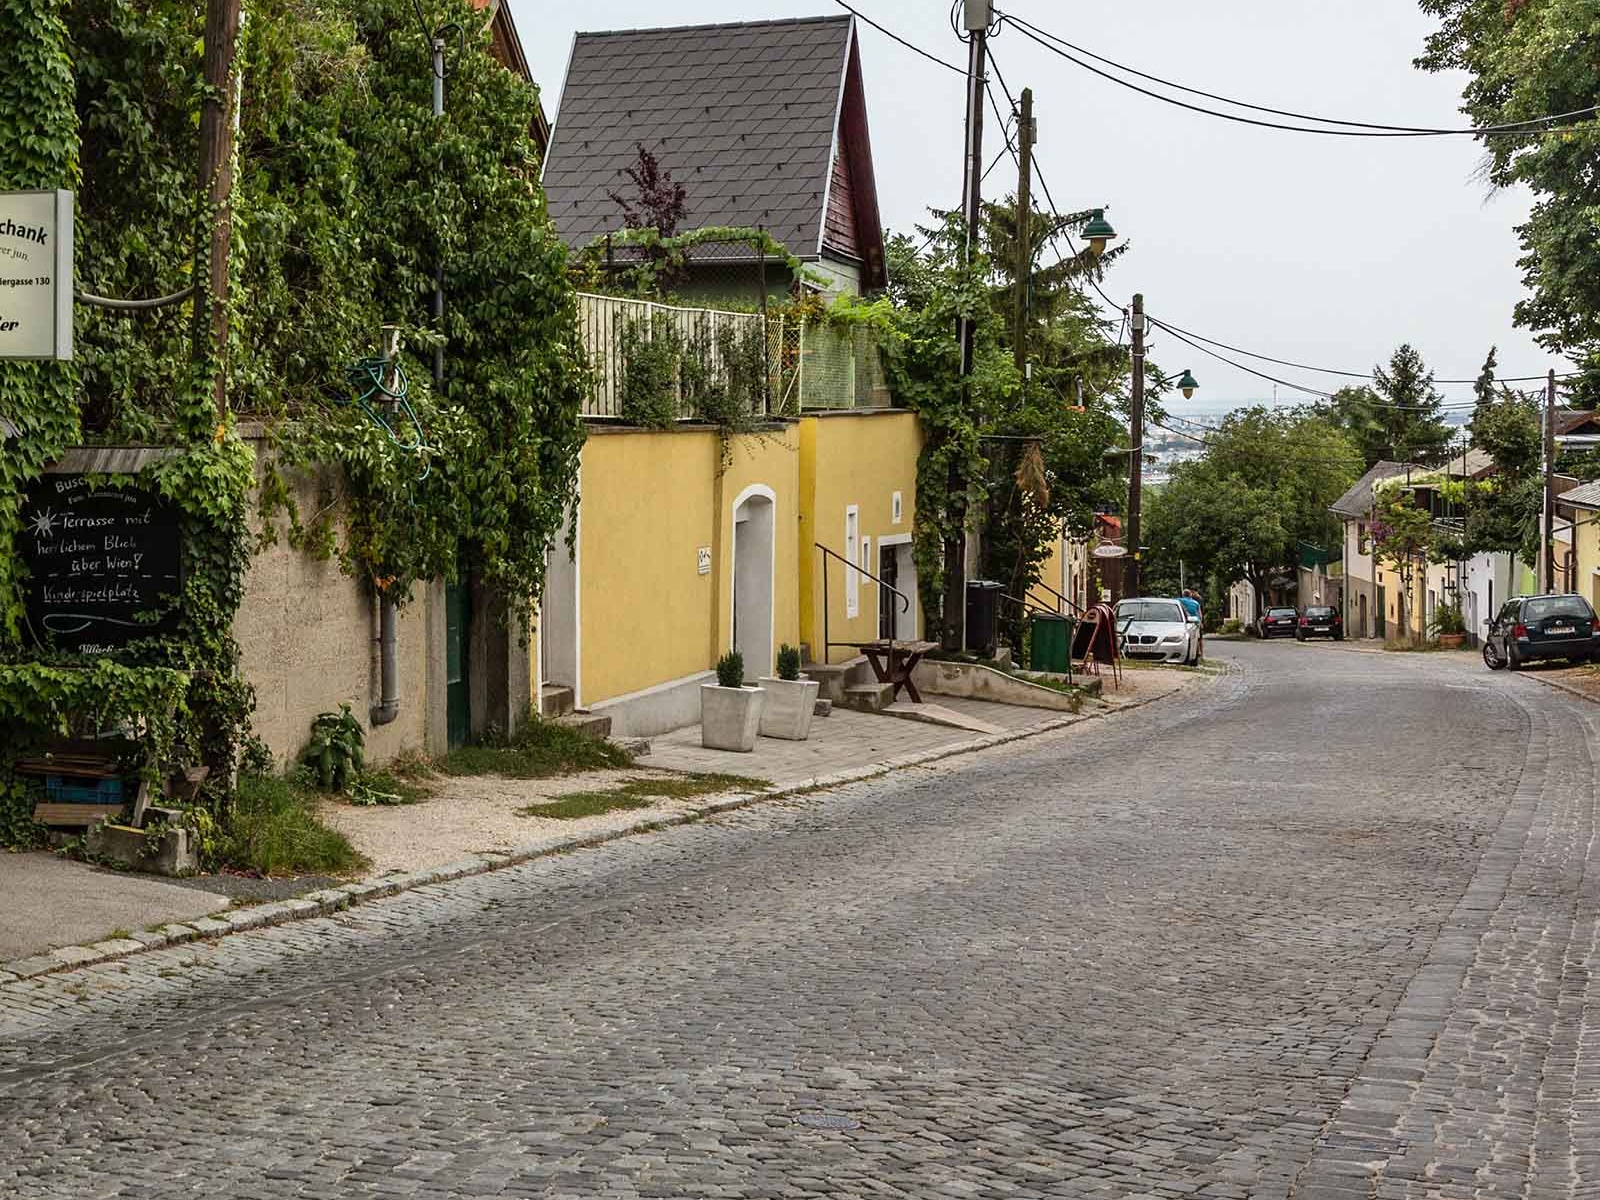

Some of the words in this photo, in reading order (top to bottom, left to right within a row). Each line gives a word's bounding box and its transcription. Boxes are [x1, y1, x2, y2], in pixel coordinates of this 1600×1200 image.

[11, 247, 30, 262] jun.
[35, 277, 50, 286] 130
[59, 512, 115, 529] Terrasse
[125, 507, 151, 524] mit
[104, 535, 137, 551] Blick
